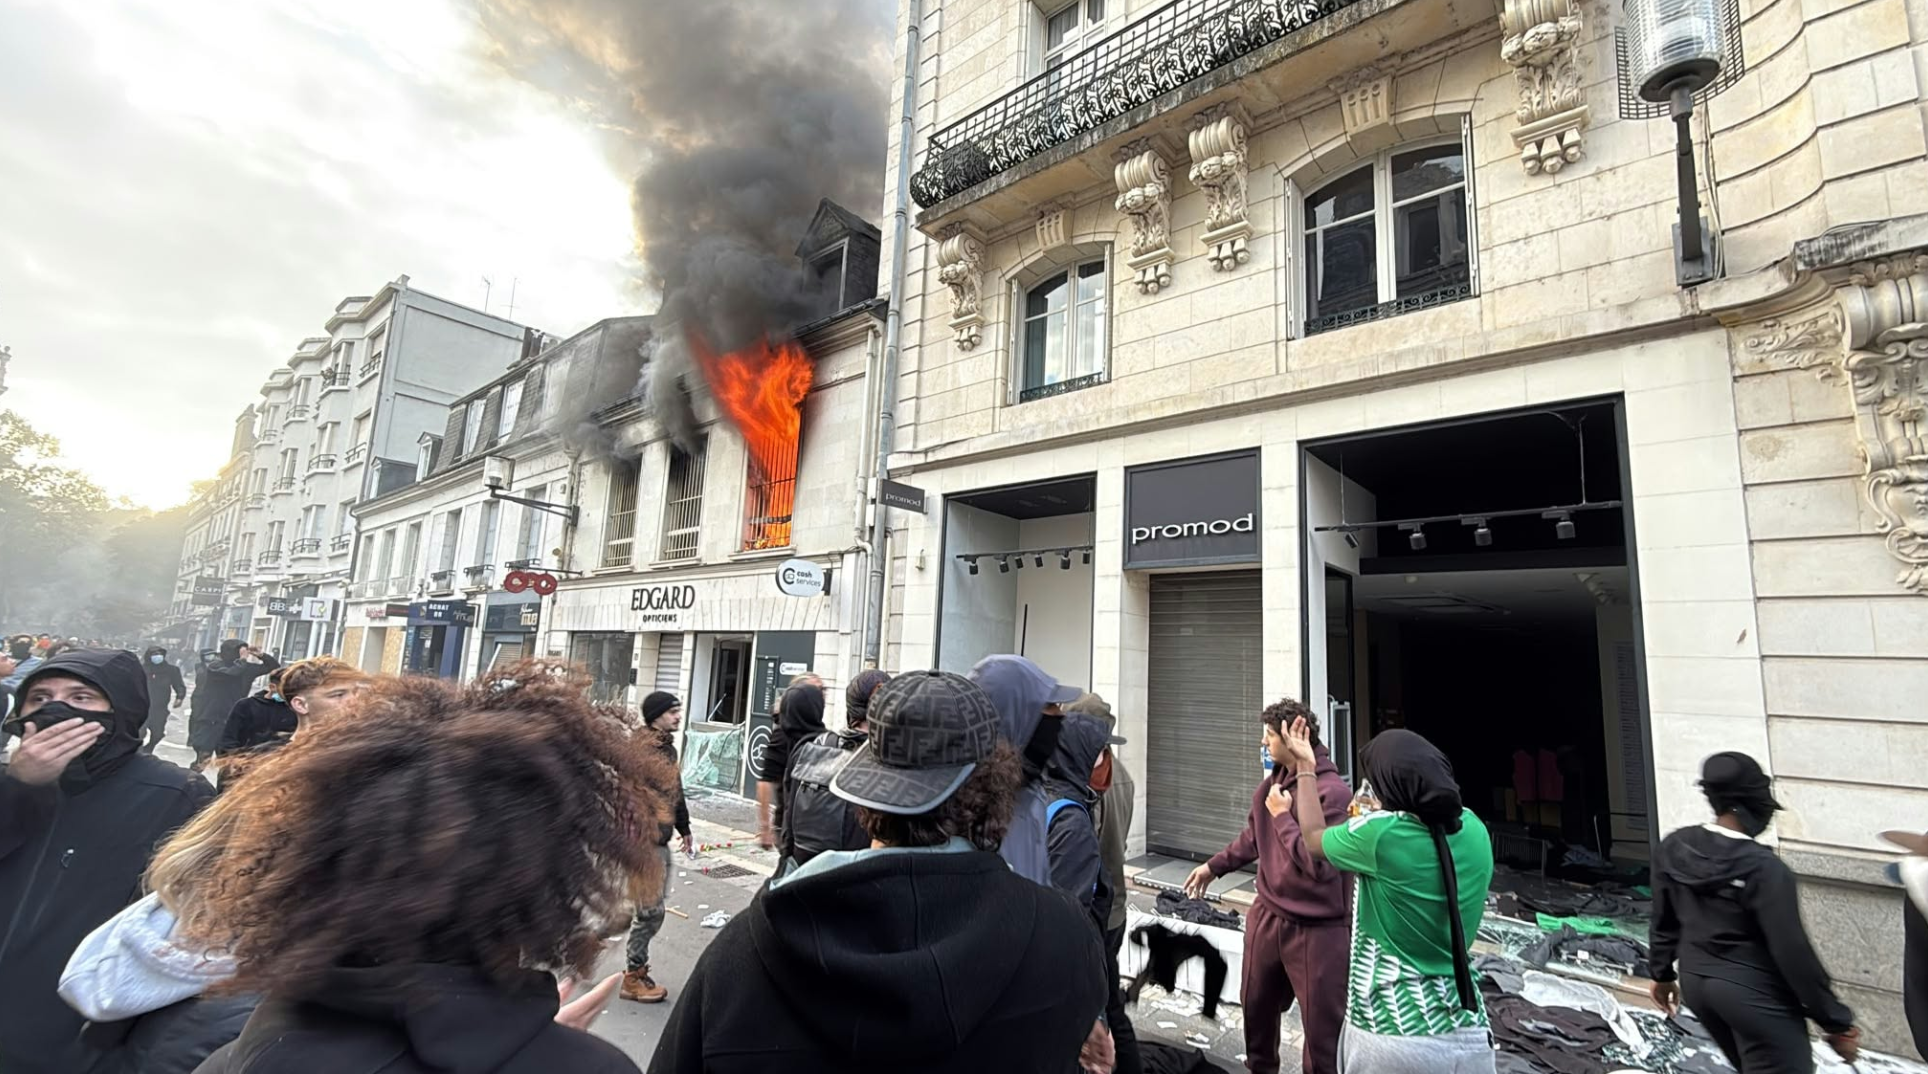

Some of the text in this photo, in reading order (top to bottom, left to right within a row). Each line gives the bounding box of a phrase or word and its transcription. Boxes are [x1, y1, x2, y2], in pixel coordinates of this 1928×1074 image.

[885, 492, 921, 507] promod
[1132, 512, 1253, 545] promod
[796, 570, 813, 578] cash
[796, 578, 821, 587] services
[630, 584, 696, 611] EDGARD
[642, 613, 678, 623] OPTICIENS
